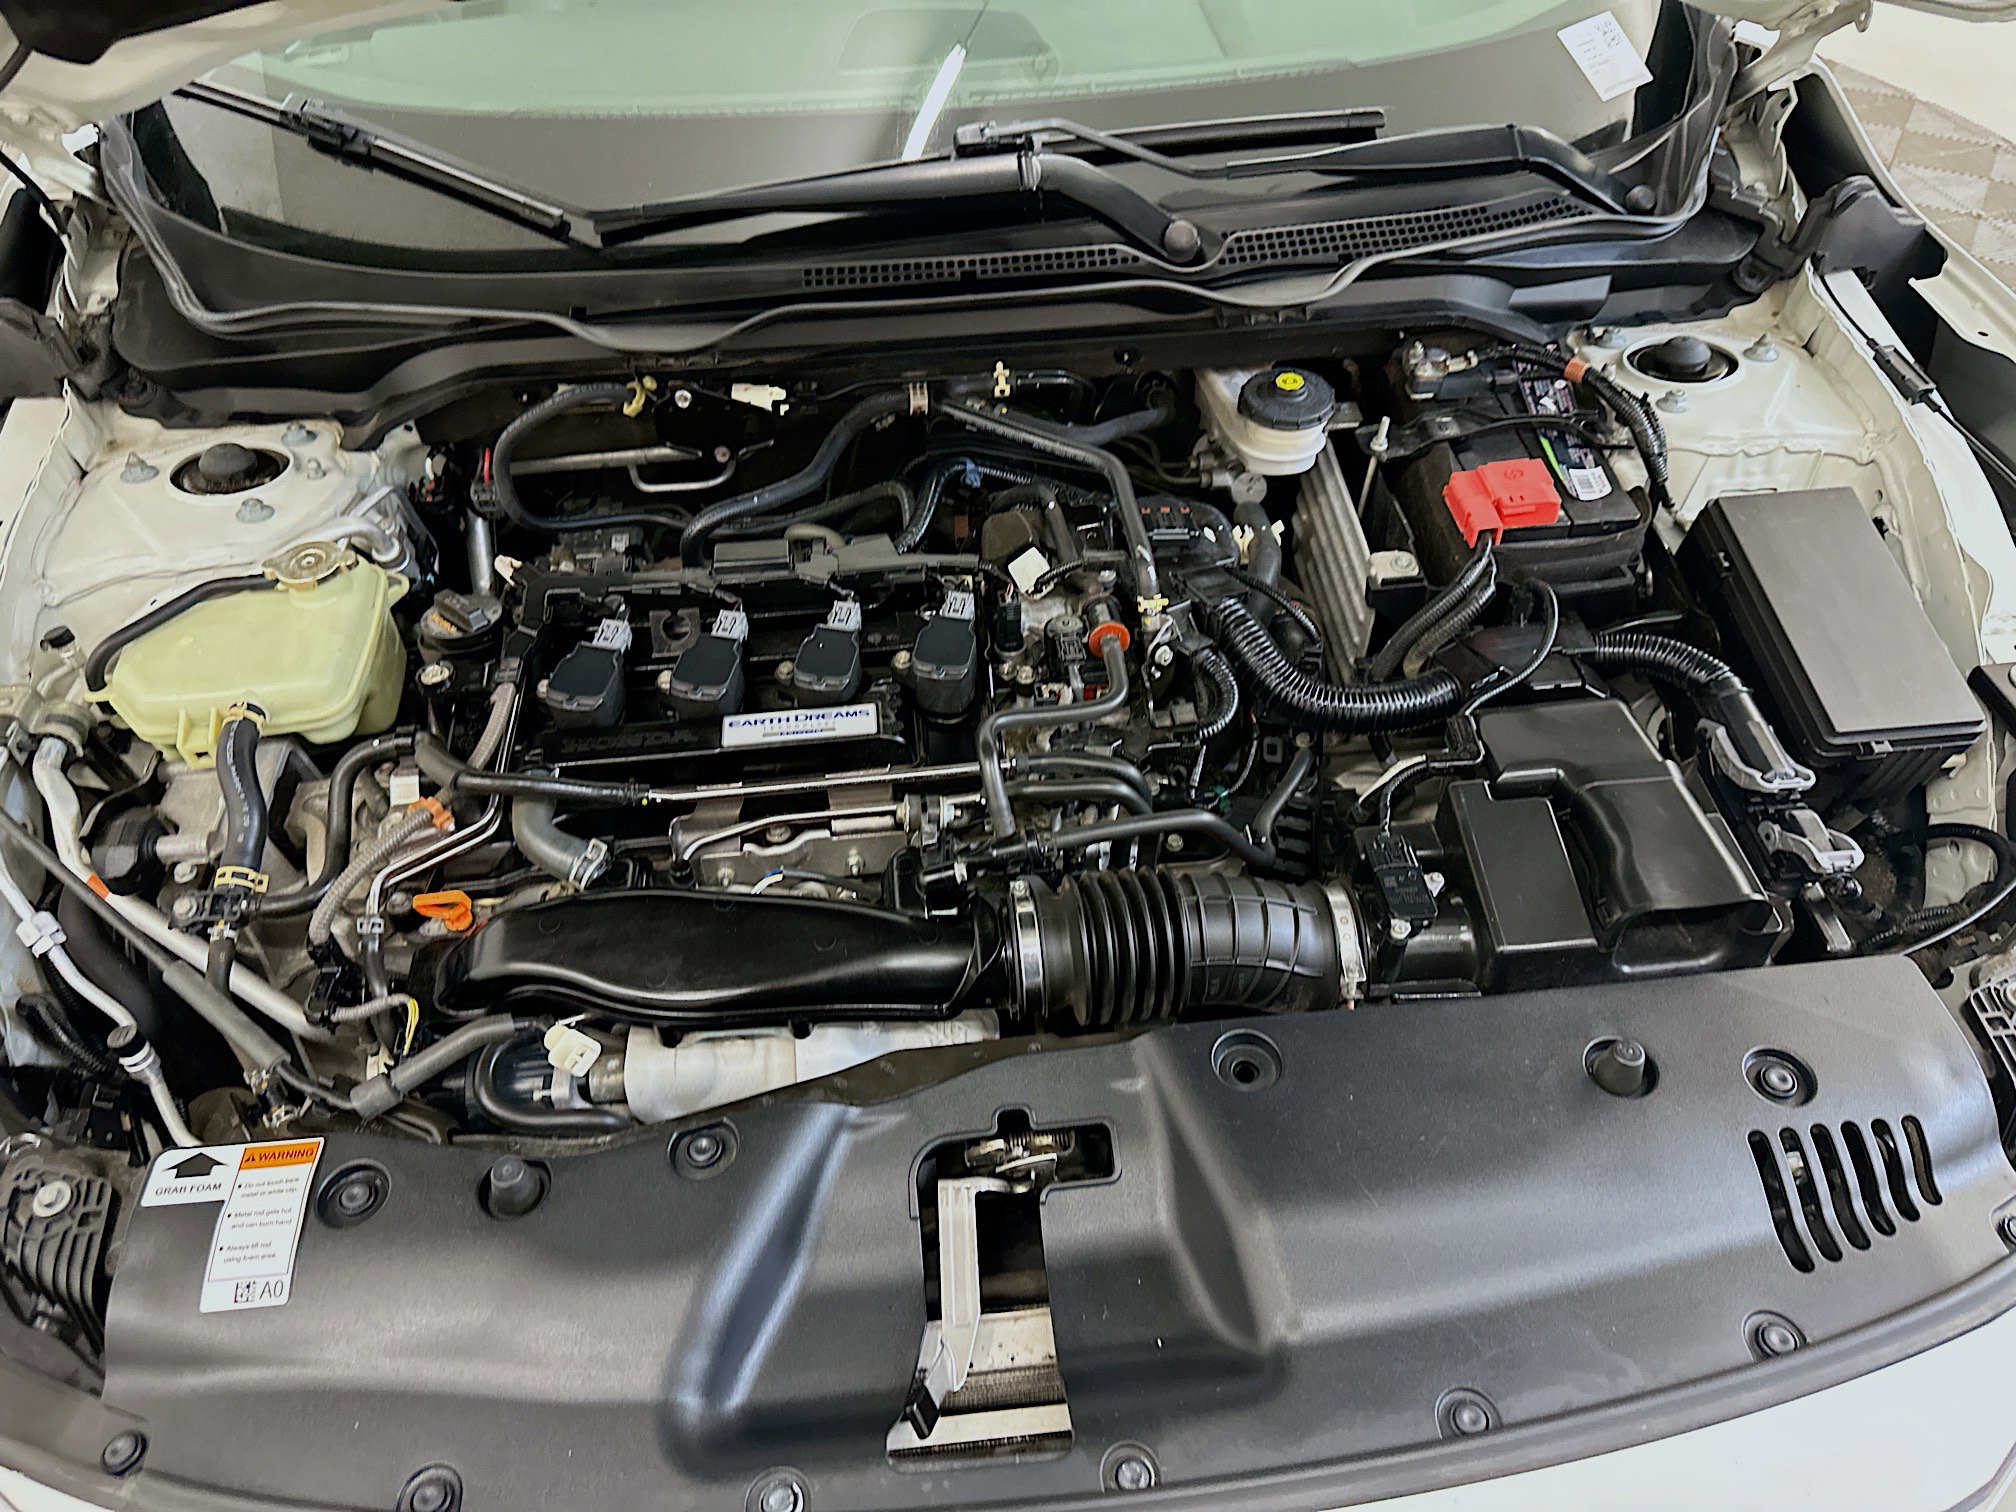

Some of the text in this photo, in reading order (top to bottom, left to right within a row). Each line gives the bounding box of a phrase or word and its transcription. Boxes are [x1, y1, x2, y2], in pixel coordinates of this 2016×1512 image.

[728, 709, 870, 728] EARTH DREAMS
[258, 1148, 315, 1162] WARNING
[155, 1182, 222, 1197] GRAB FOAM
[234, 1210, 253, 1218] Metal
[226, 1243, 250, 1252] Always
